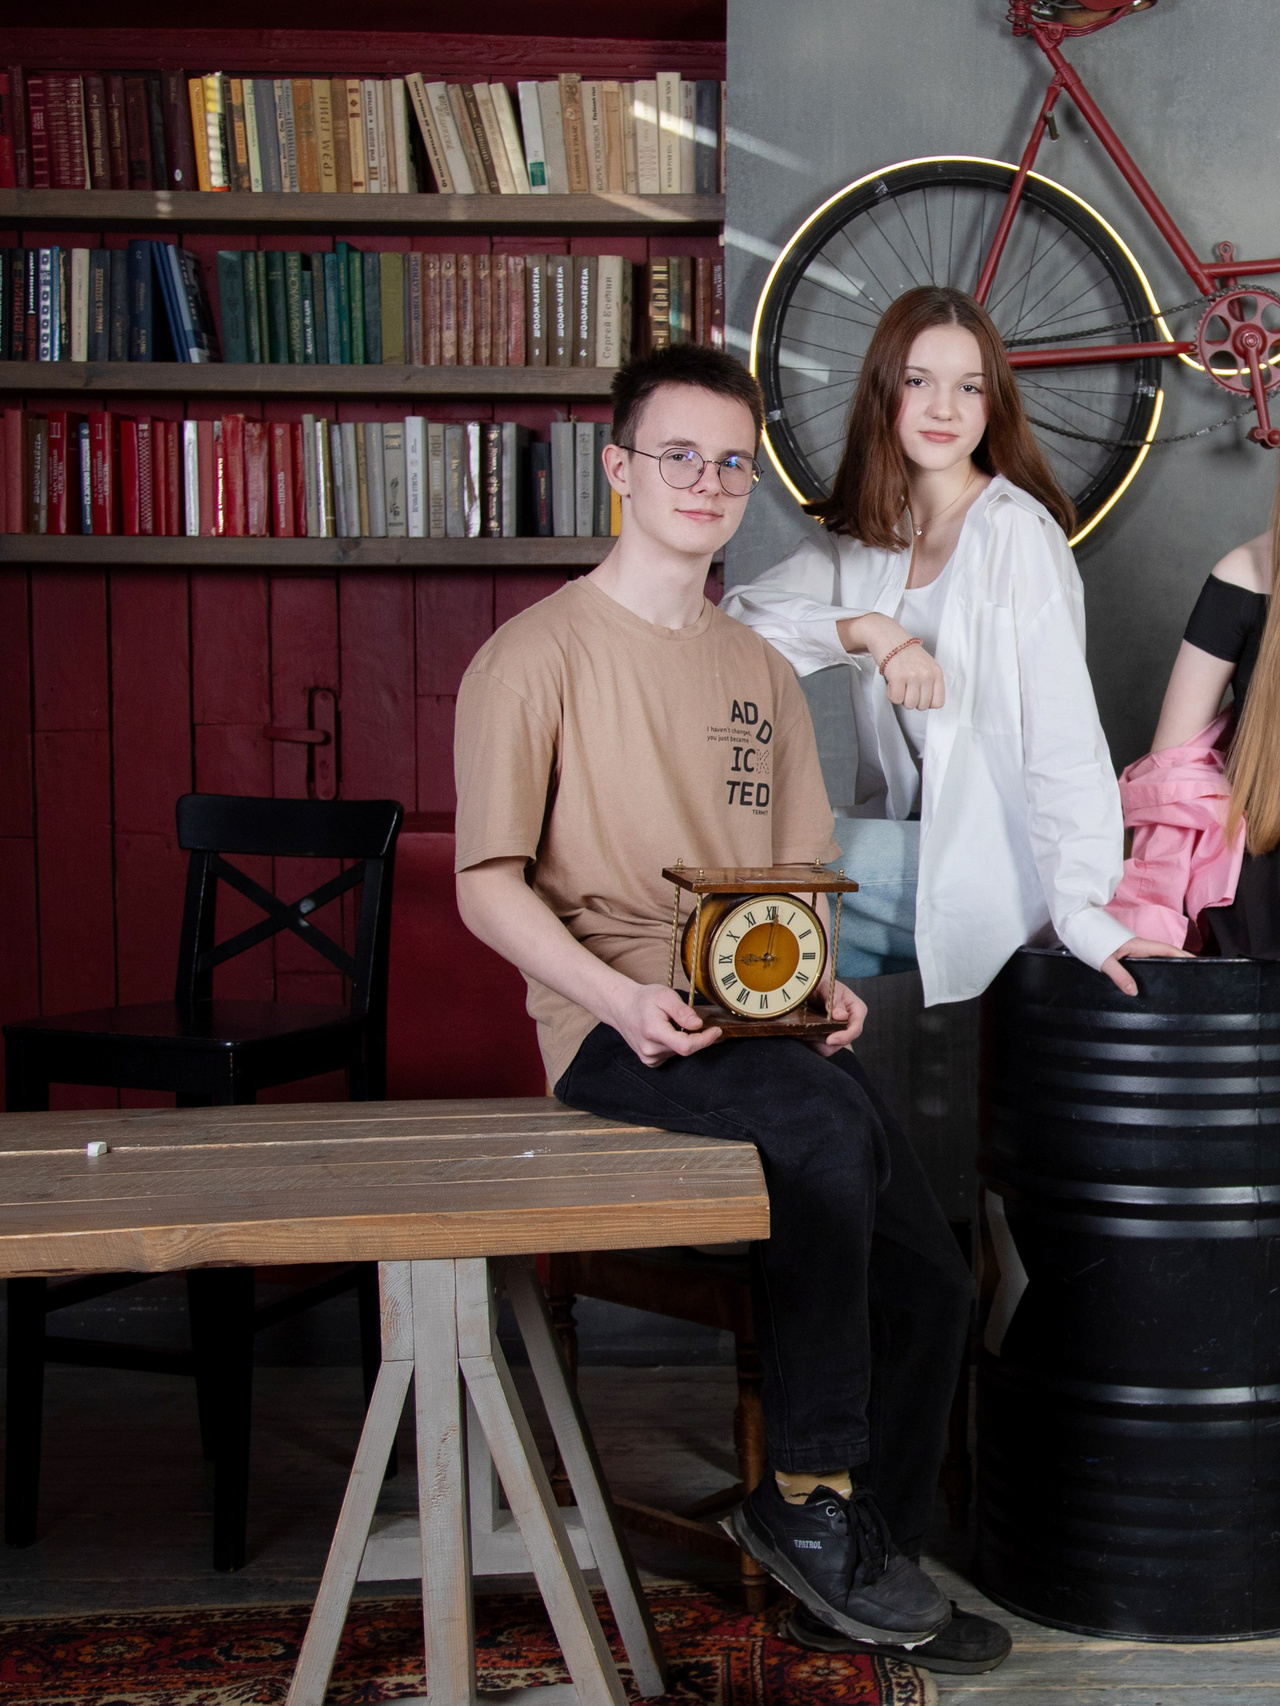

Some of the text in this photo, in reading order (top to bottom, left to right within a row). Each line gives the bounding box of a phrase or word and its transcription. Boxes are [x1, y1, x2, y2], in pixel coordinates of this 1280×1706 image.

[92, 94, 99, 104] 2
[91, 108, 105, 177] Григорий Медынский
[318, 95, 334, 178] ГРЭМ ГРИН
[440, 179, 448, 188] От
[594, 164, 604, 191] БОРИС
[287, 256, 300, 304] ЛУКОНИН
[411, 258, 420, 294] САТИРЫ
[413, 295, 421, 321] КНИГА
[532, 266, 541, 338] ШОЛОМ-АЛЕЙХЕМ
[556, 266, 565, 337] ШОЛОМ-АЛЕЙХЕМ
[580, 268, 589, 339] ШОЛОМ-АЛЕЙХЕМ
[602, 276, 614, 359] Сергей Есенин
[277, 471, 285, 504] ПИКУЛЬ
[710, 726, 731, 734] haven't
[717, 735, 730, 743] just
[730, 736, 750, 744] became
[726, 780, 770, 807] TED
[743, 911, 757, 928] XI
[786, 912, 796, 926] I
[726, 930, 741, 942] X
[798, 929, 812, 940] II
[718, 954, 733, 964] IX
[802, 952, 816, 960] III
[721, 971, 738, 991] VIII
[795, 971, 810, 986] IV
[736, 987, 751, 1006] VII
[759, 994, 769, 1010] VI
[782, 988, 791, 1003] V
[798, 1540, 823, 1549] PATROL
